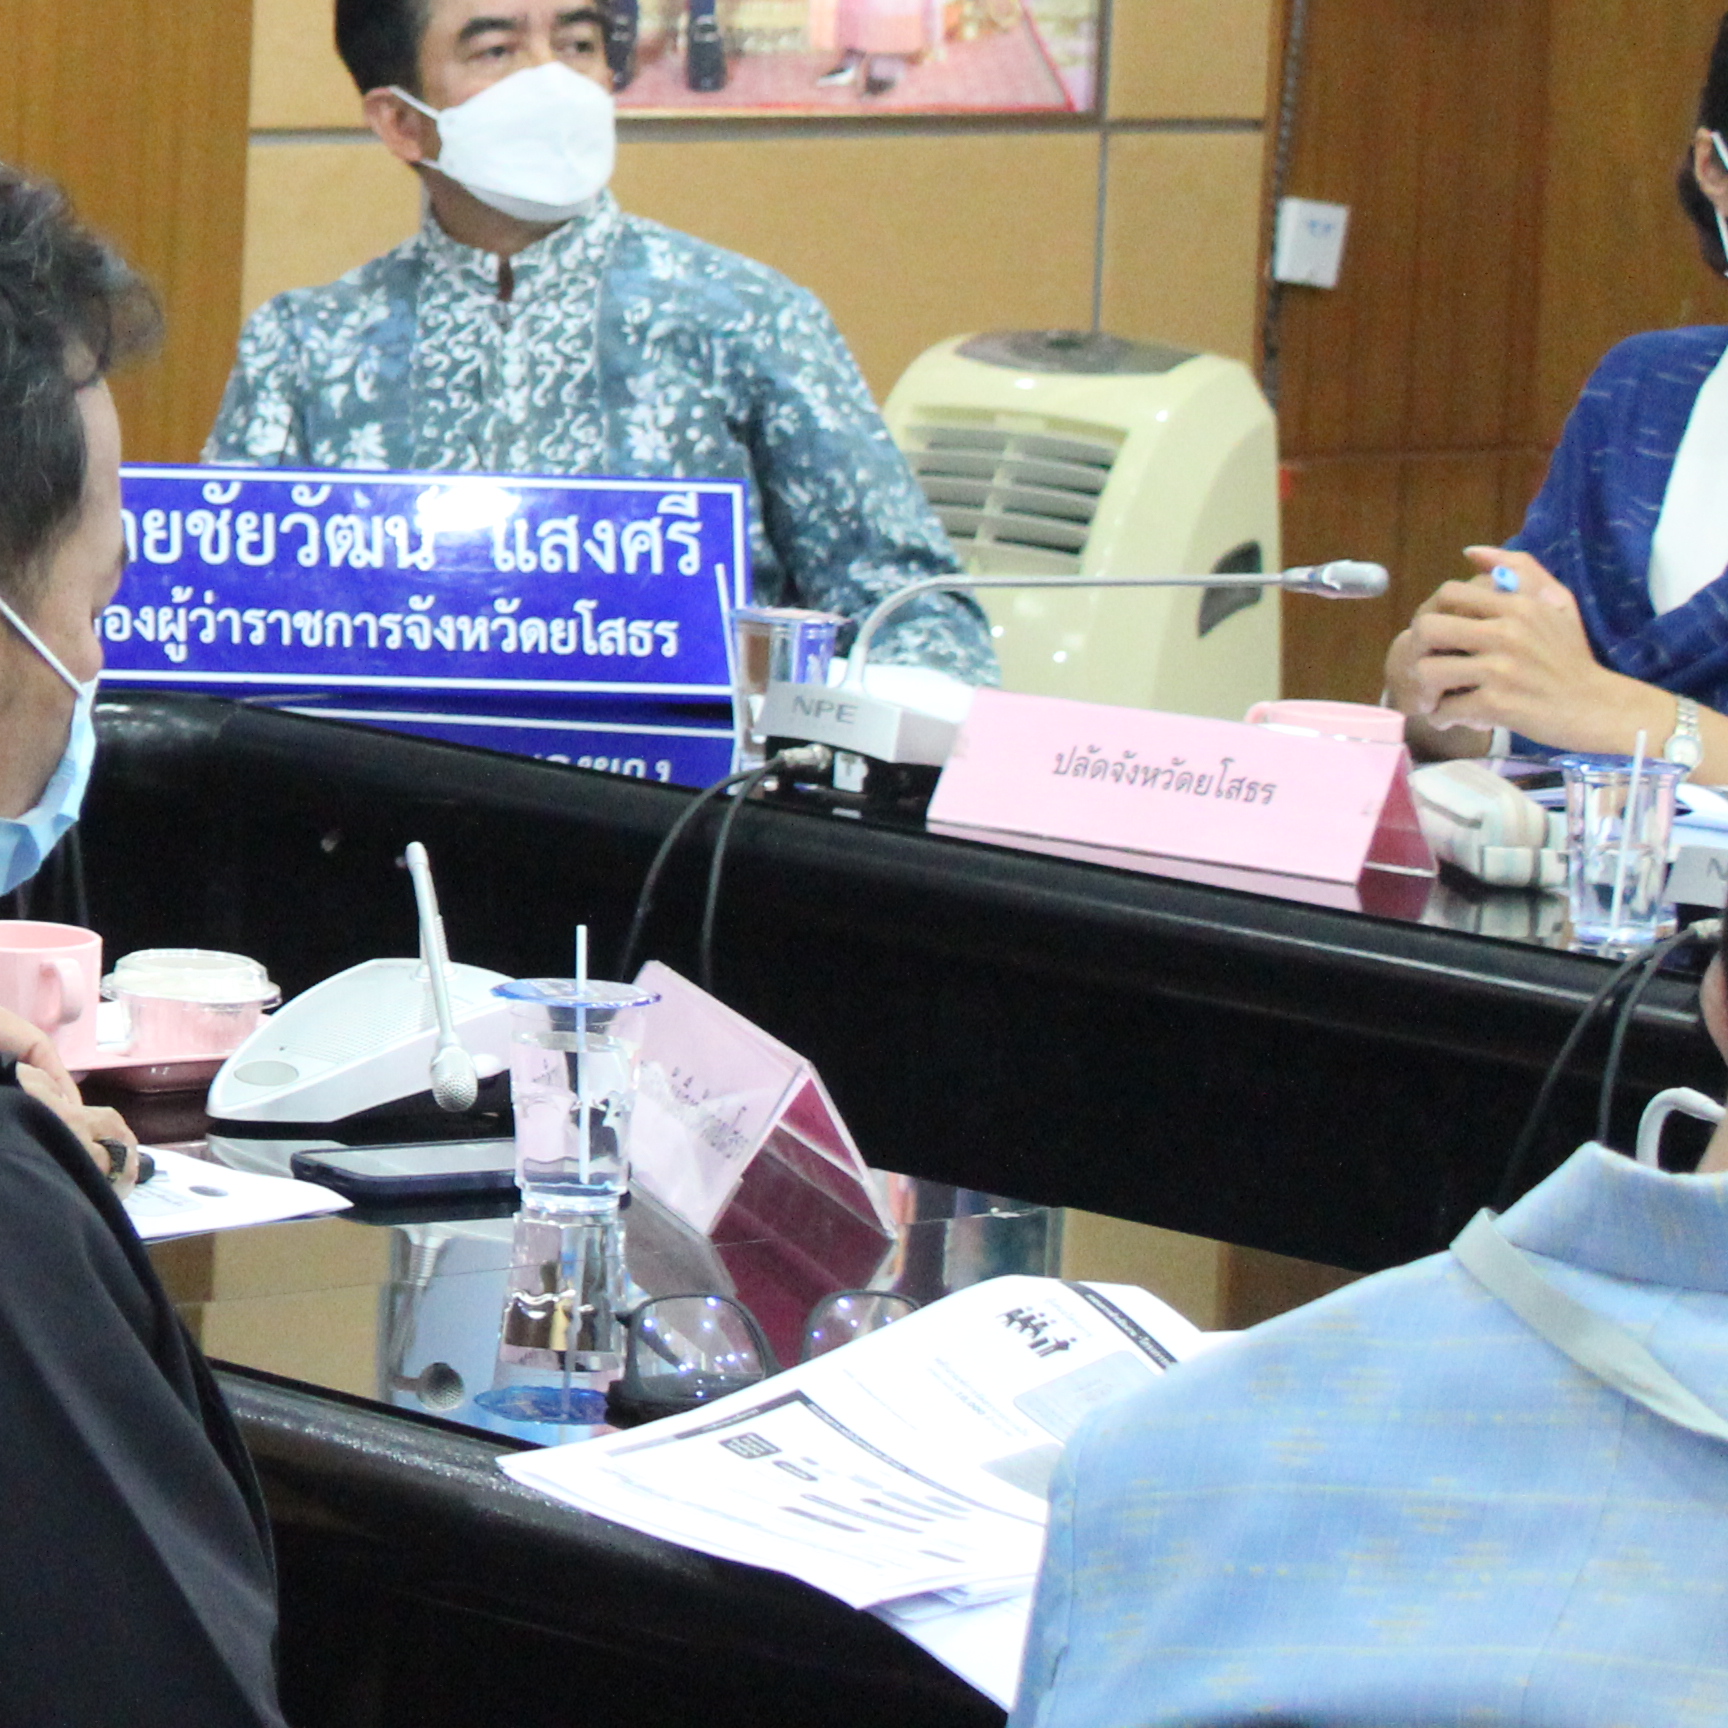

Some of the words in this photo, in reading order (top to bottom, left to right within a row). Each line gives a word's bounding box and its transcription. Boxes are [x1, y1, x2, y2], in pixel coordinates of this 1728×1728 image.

[119, 480, 441, 571] ายชัยวัฒน์
[492, 491, 704, 576] แสงศรี
[94, 585, 680, 663] องผู้ว่าราชการจังหวัดยโสธร
[791, 694, 859, 725] NPE
[1052, 744, 1278, 806] ปลัดจังหวัดยโสธร
